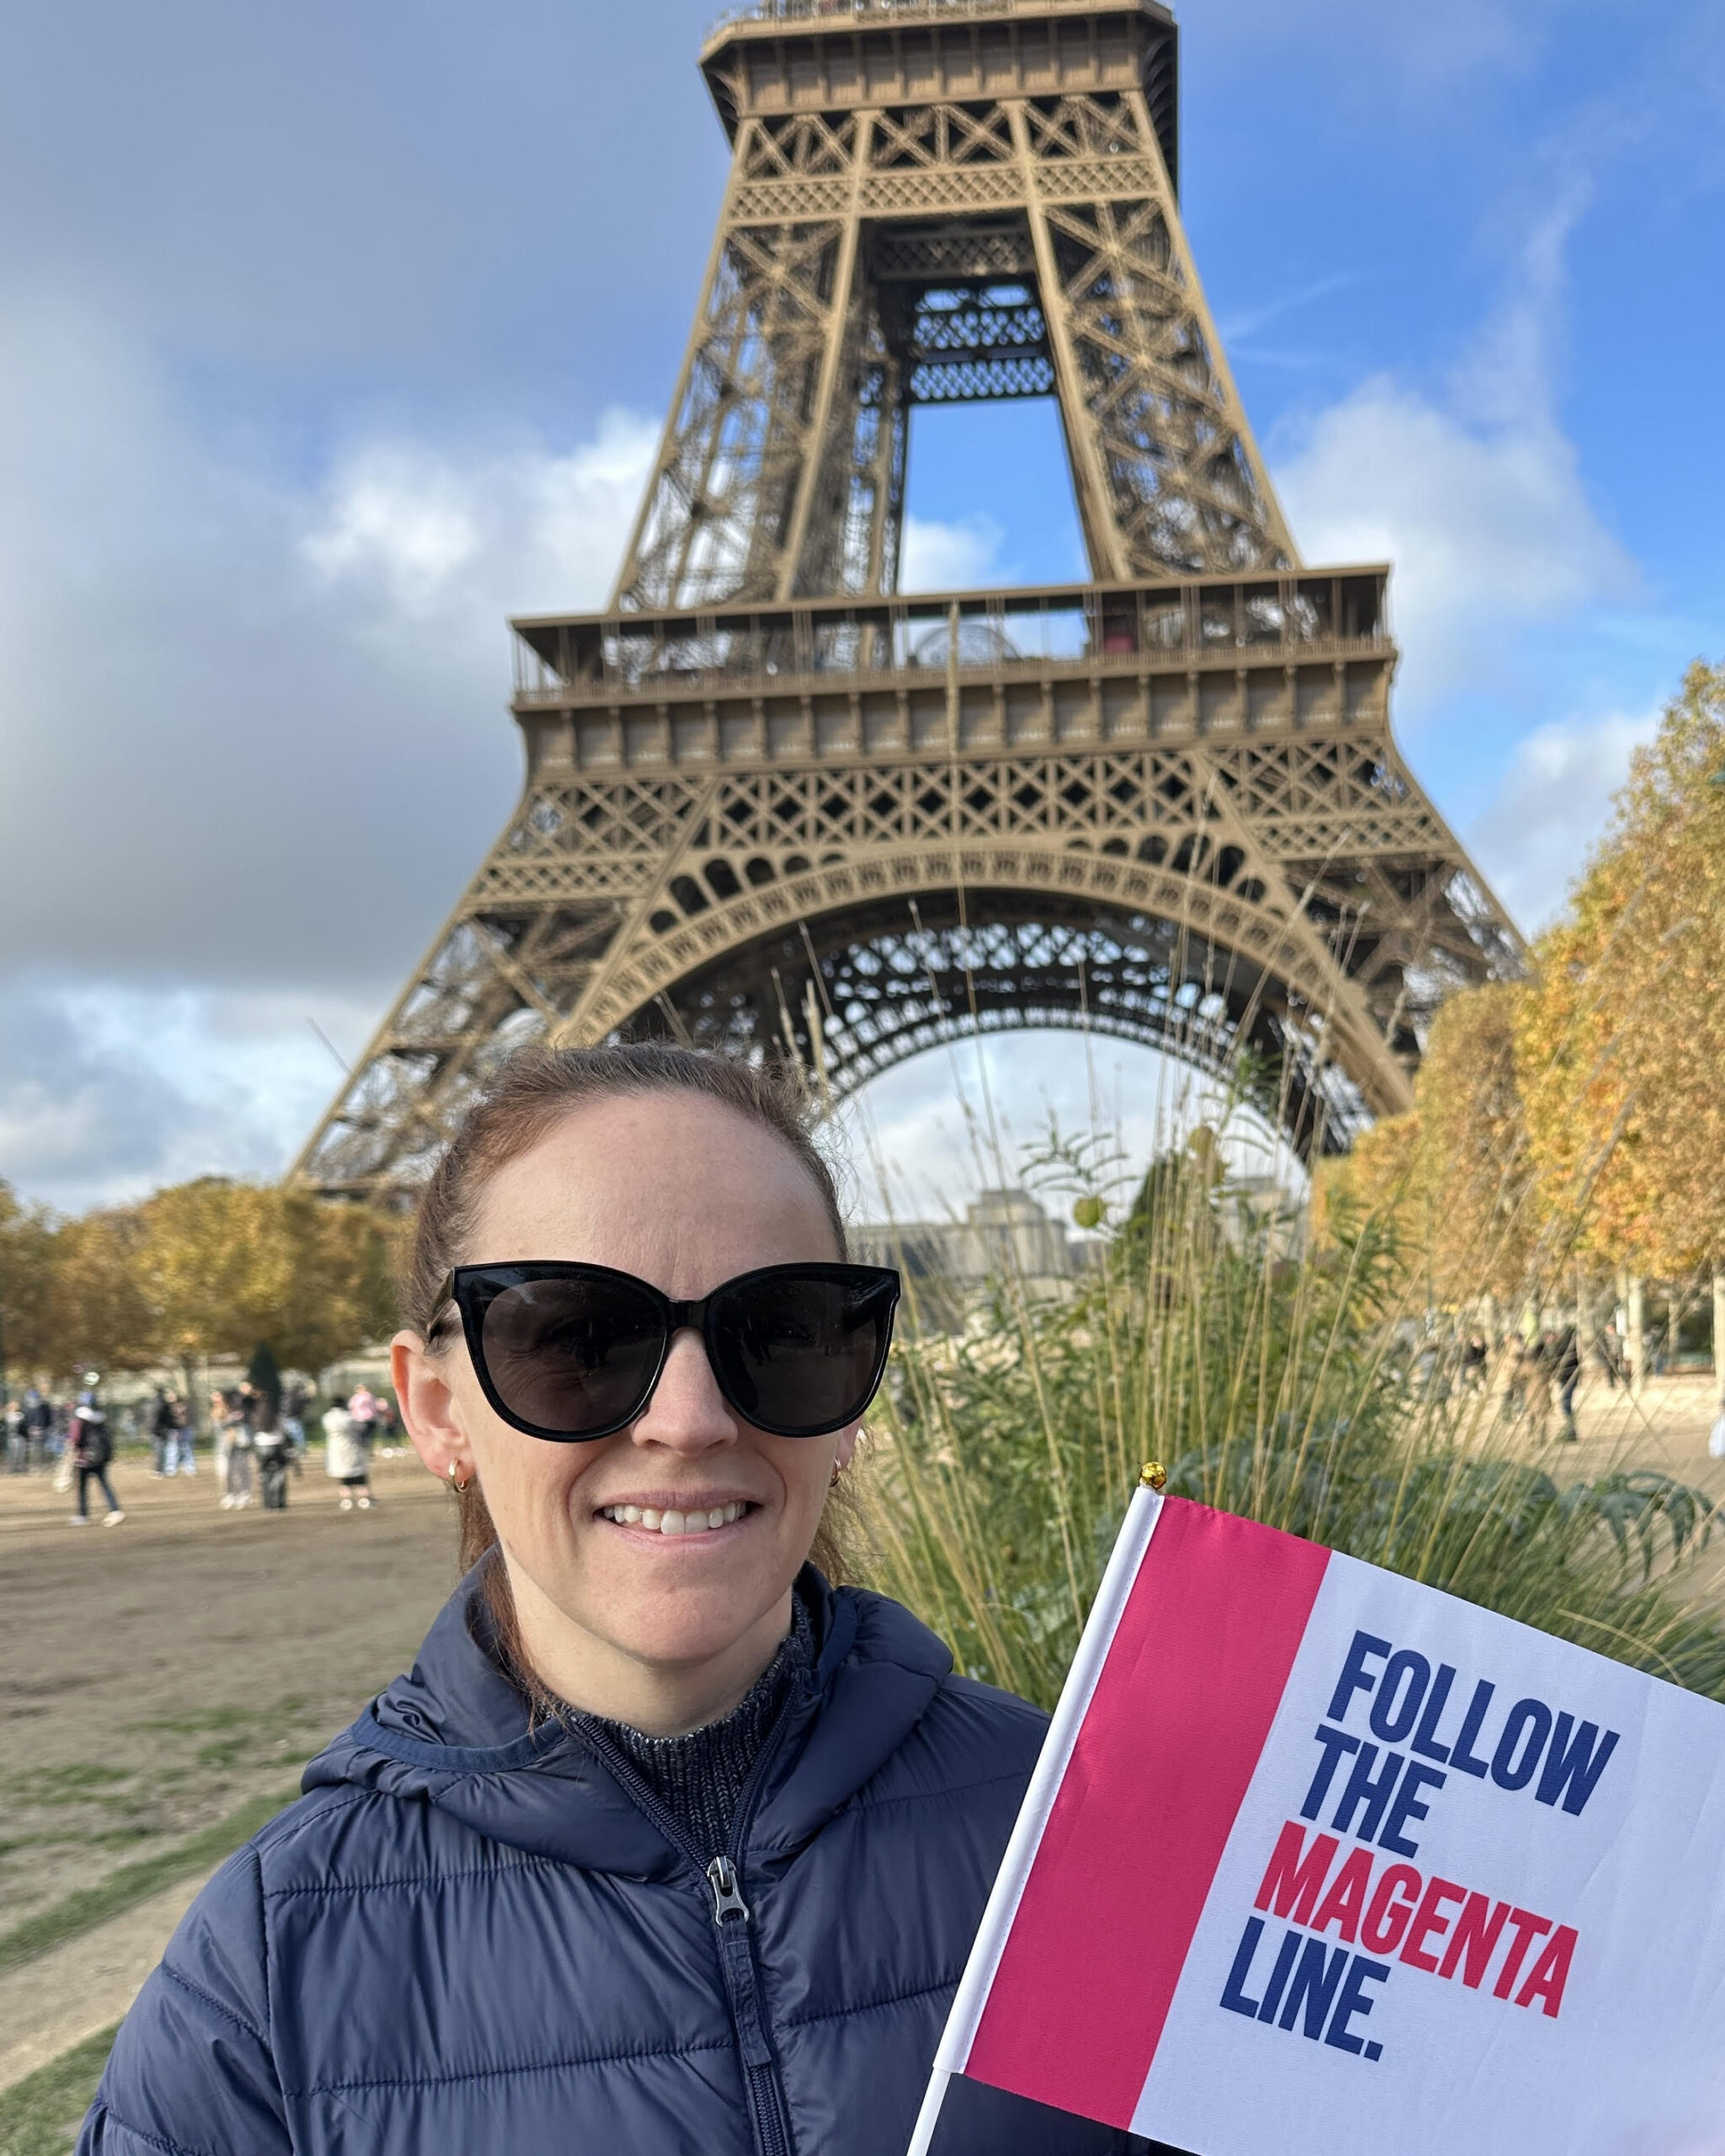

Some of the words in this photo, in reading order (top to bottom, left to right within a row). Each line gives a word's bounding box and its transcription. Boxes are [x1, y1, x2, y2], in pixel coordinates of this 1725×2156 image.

[1300, 1724, 1447, 1859] THE
[1327, 1630, 1621, 1817] FOLLOW
[1220, 1916, 1391, 2062] LINE.
[1253, 1820, 1578, 2019] MAGENTA
